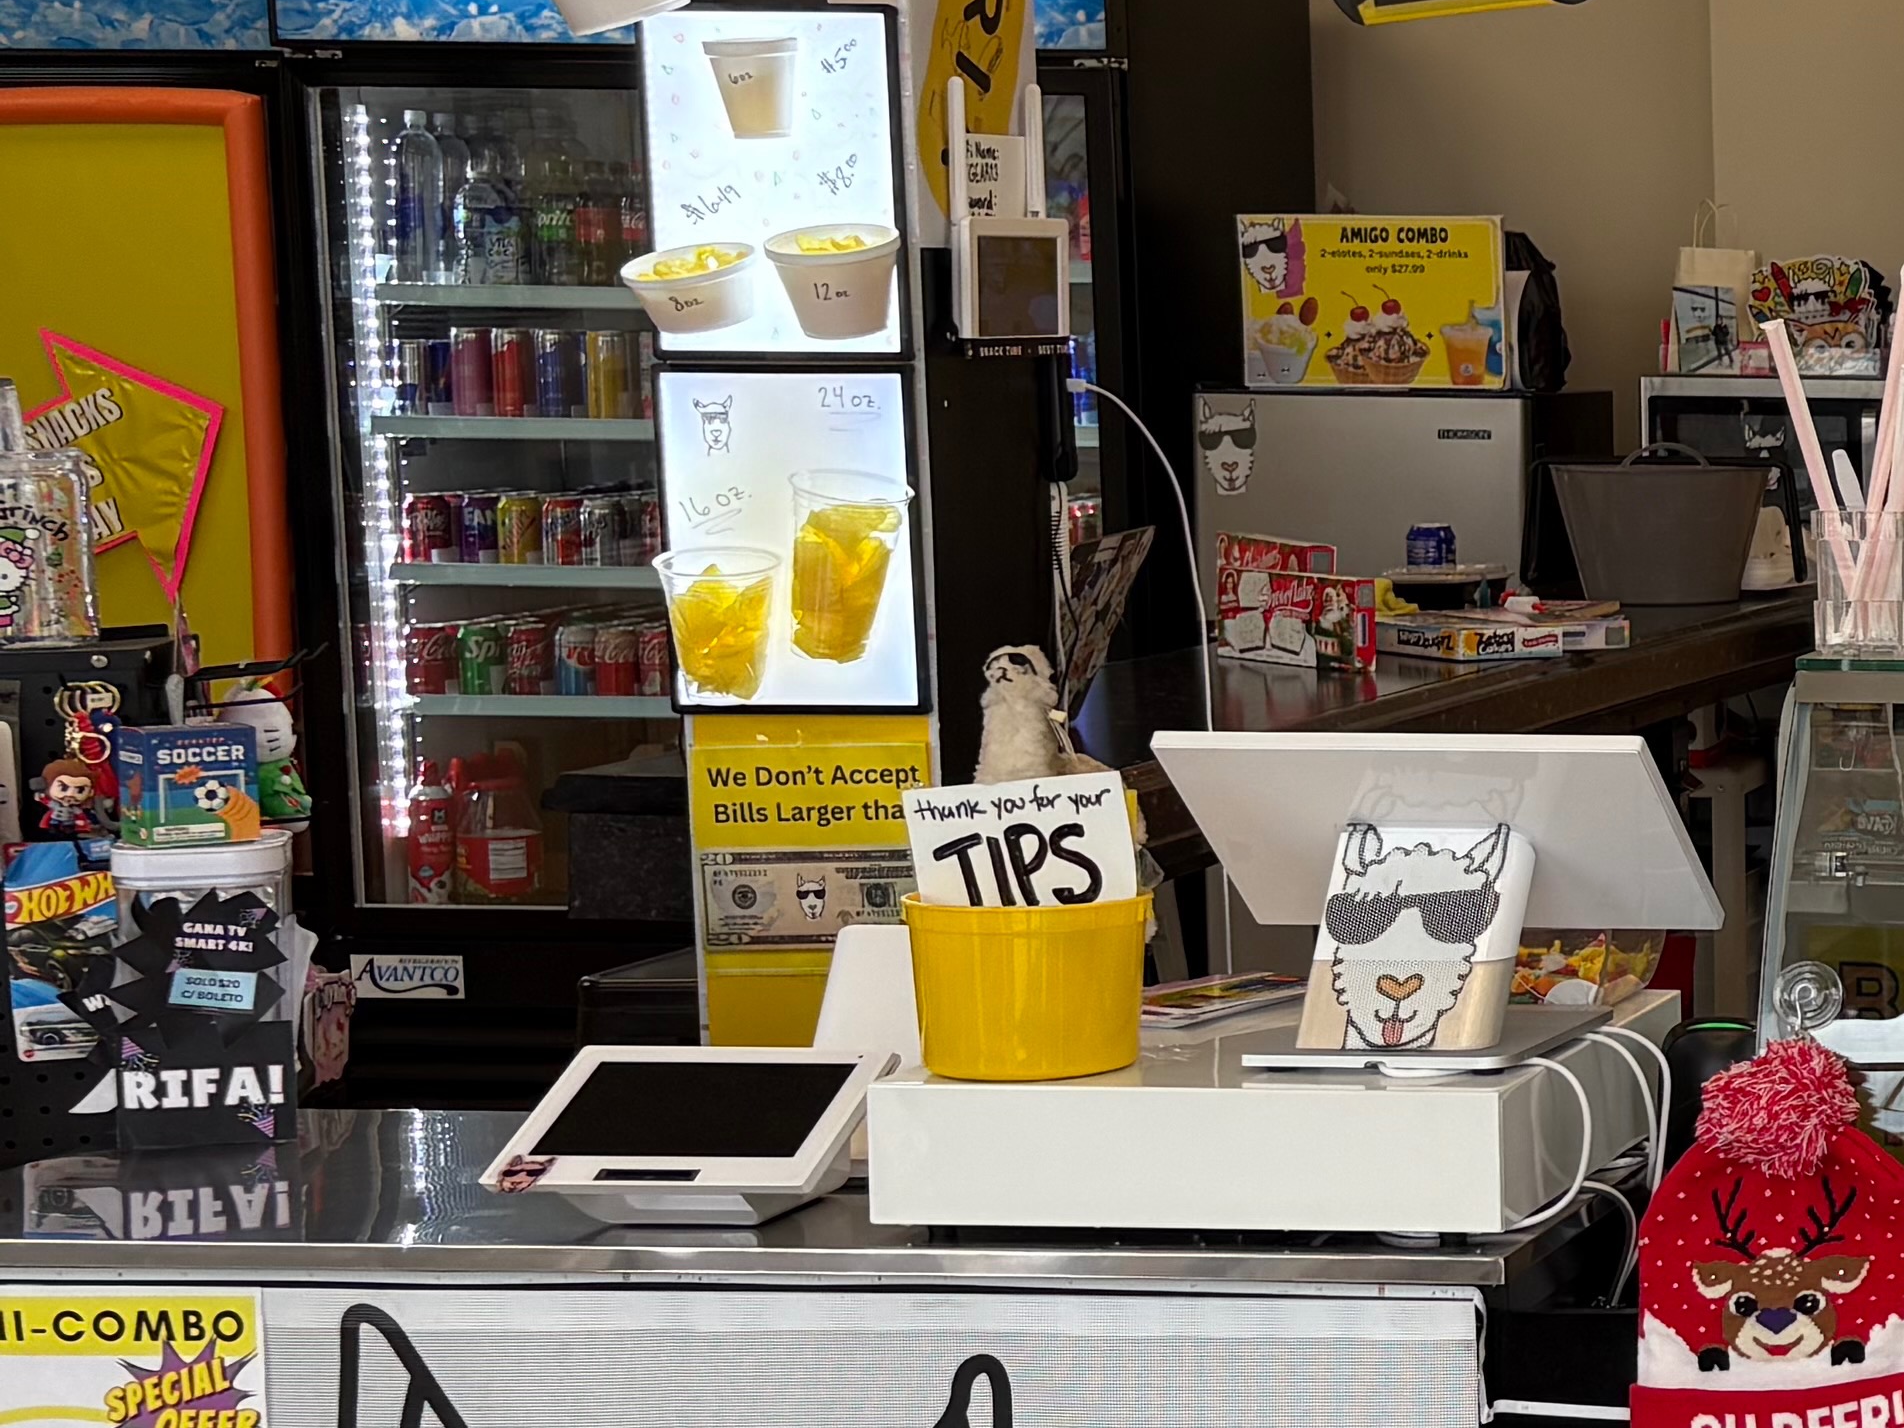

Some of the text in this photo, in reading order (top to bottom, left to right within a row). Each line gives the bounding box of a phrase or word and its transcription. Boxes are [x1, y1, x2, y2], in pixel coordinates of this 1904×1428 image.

[1339, 225, 1449, 245] AMIGO COMBO
[818, 385, 846, 409] 24
[156, 745, 246, 766] SOCCER
[706, 763, 920, 790] We Don't Accept
[714, 800, 856, 829] Bills Larger
[915, 784, 1112, 822] thank you for your
[932, 822, 1104, 908] TIPS
[182, 922, 247, 938] GANA TV
[174, 937, 227, 952] SMART
[356, 957, 460, 985] AVANTCO
[122, 1064, 286, 1111] RIFA!
[0, 1307, 246, 1344] I-COMBO
[103, 1357, 232, 1424] SPECIAL
